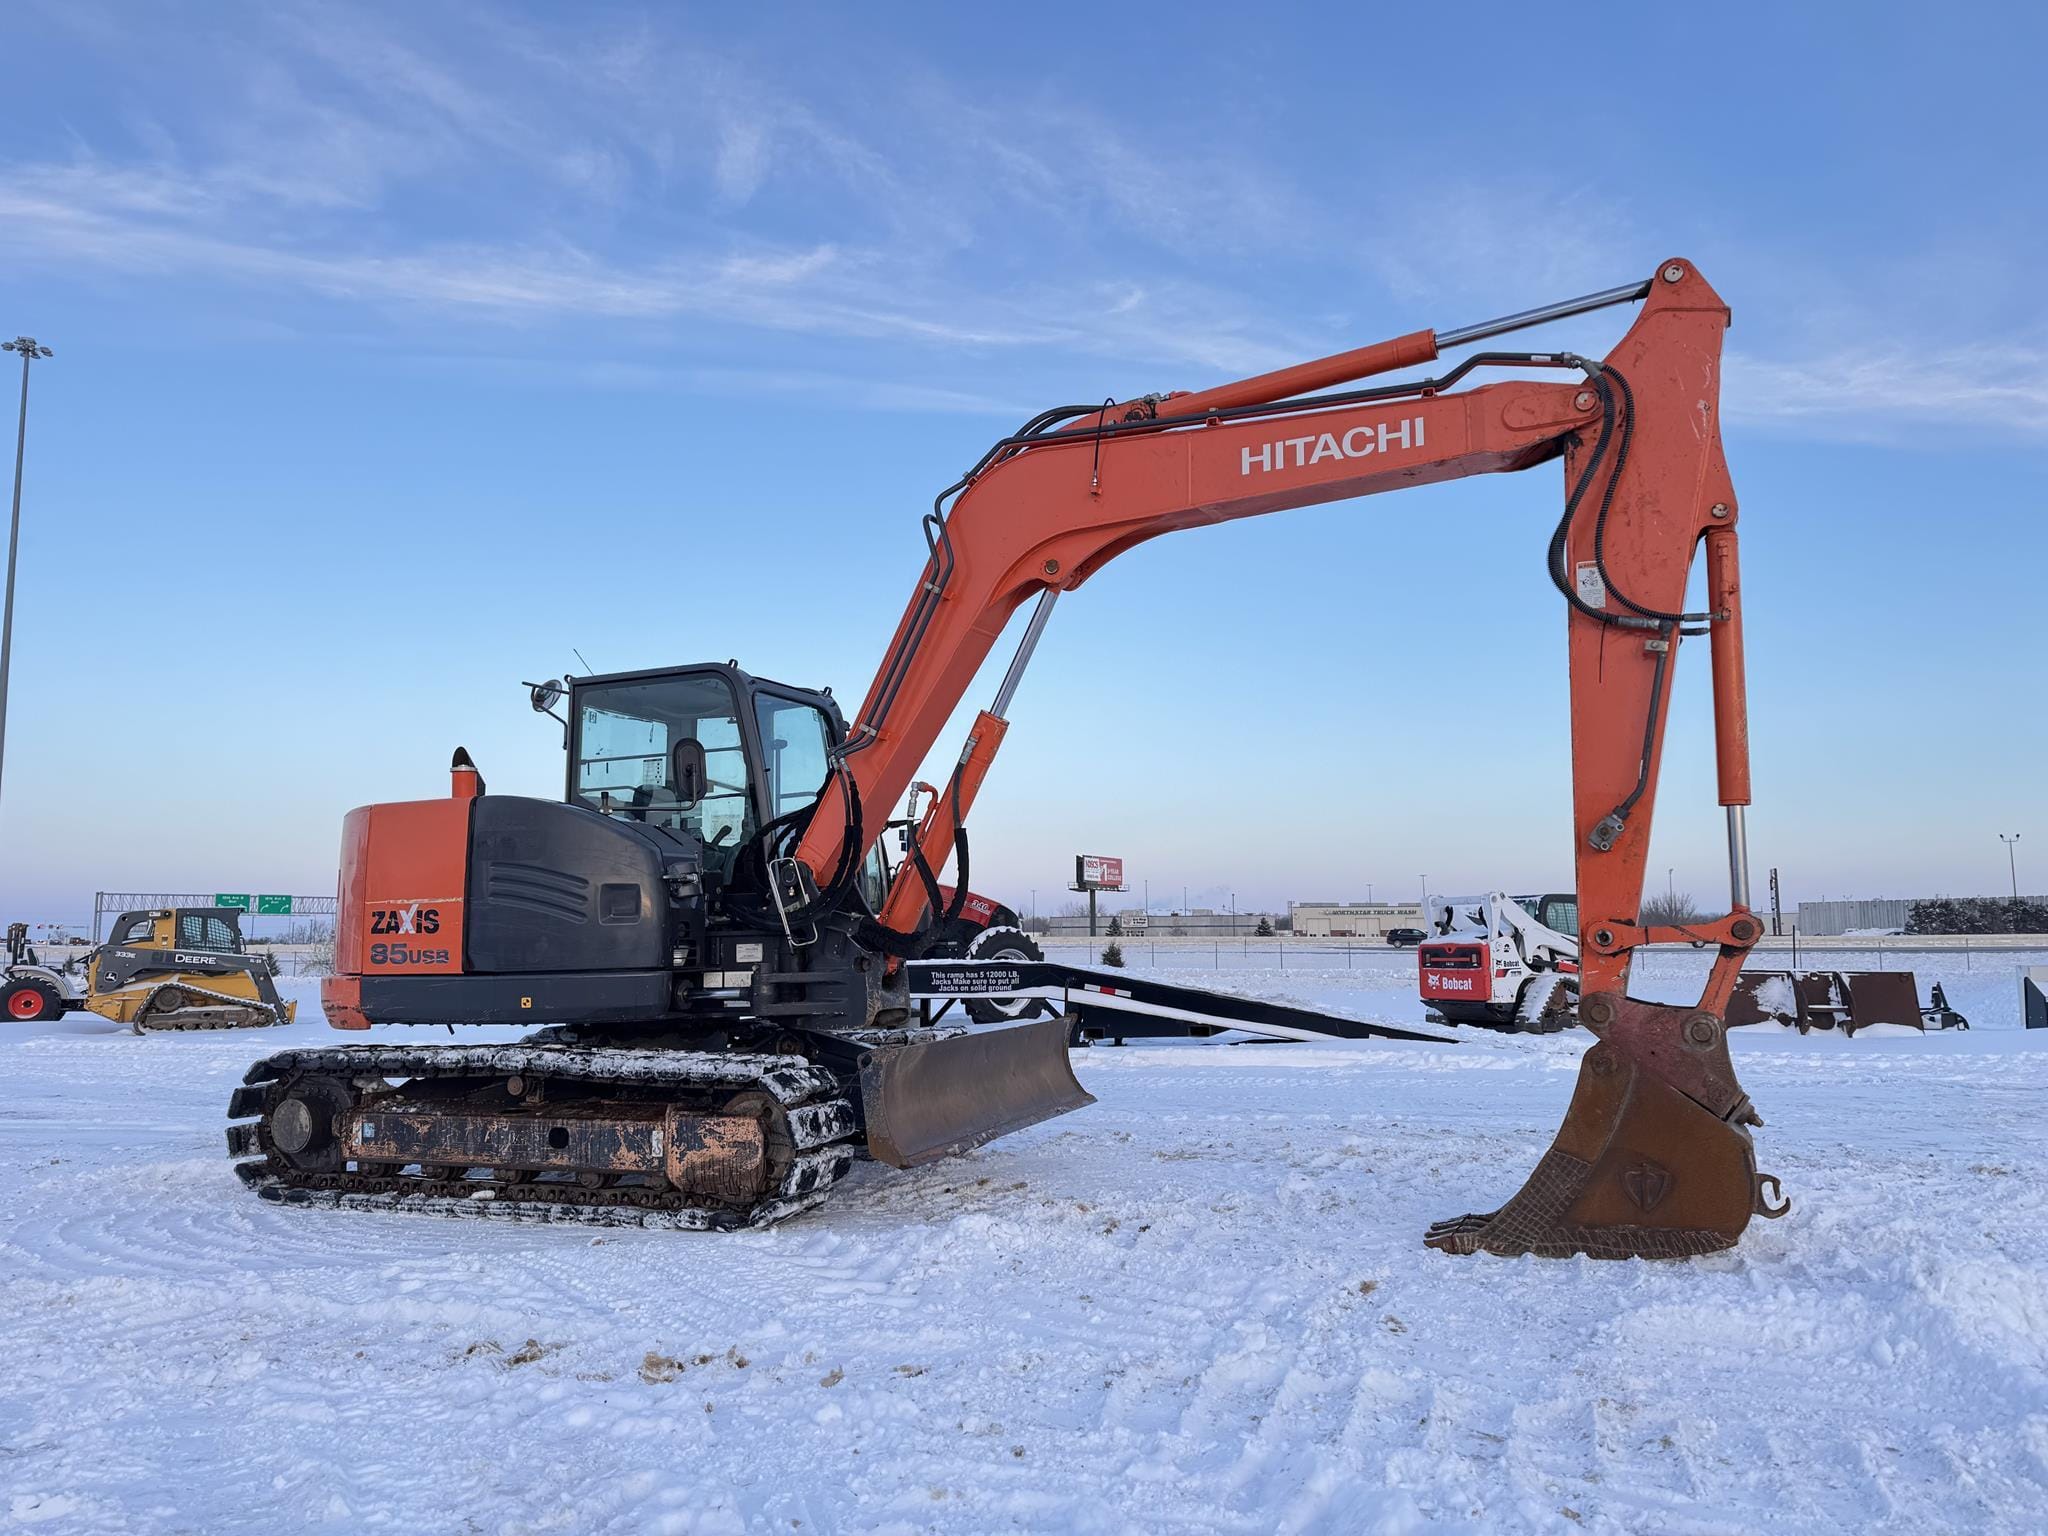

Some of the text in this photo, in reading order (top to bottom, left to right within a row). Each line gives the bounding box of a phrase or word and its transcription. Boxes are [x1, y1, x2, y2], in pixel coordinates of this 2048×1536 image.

[1241, 417, 1425, 476] HITACHI
[371, 904, 439, 934] ZAXIS
[175, 954, 216, 965] DEERE
[998, 978, 1009, 986] put
[1442, 977, 1473, 991] Bobcat
